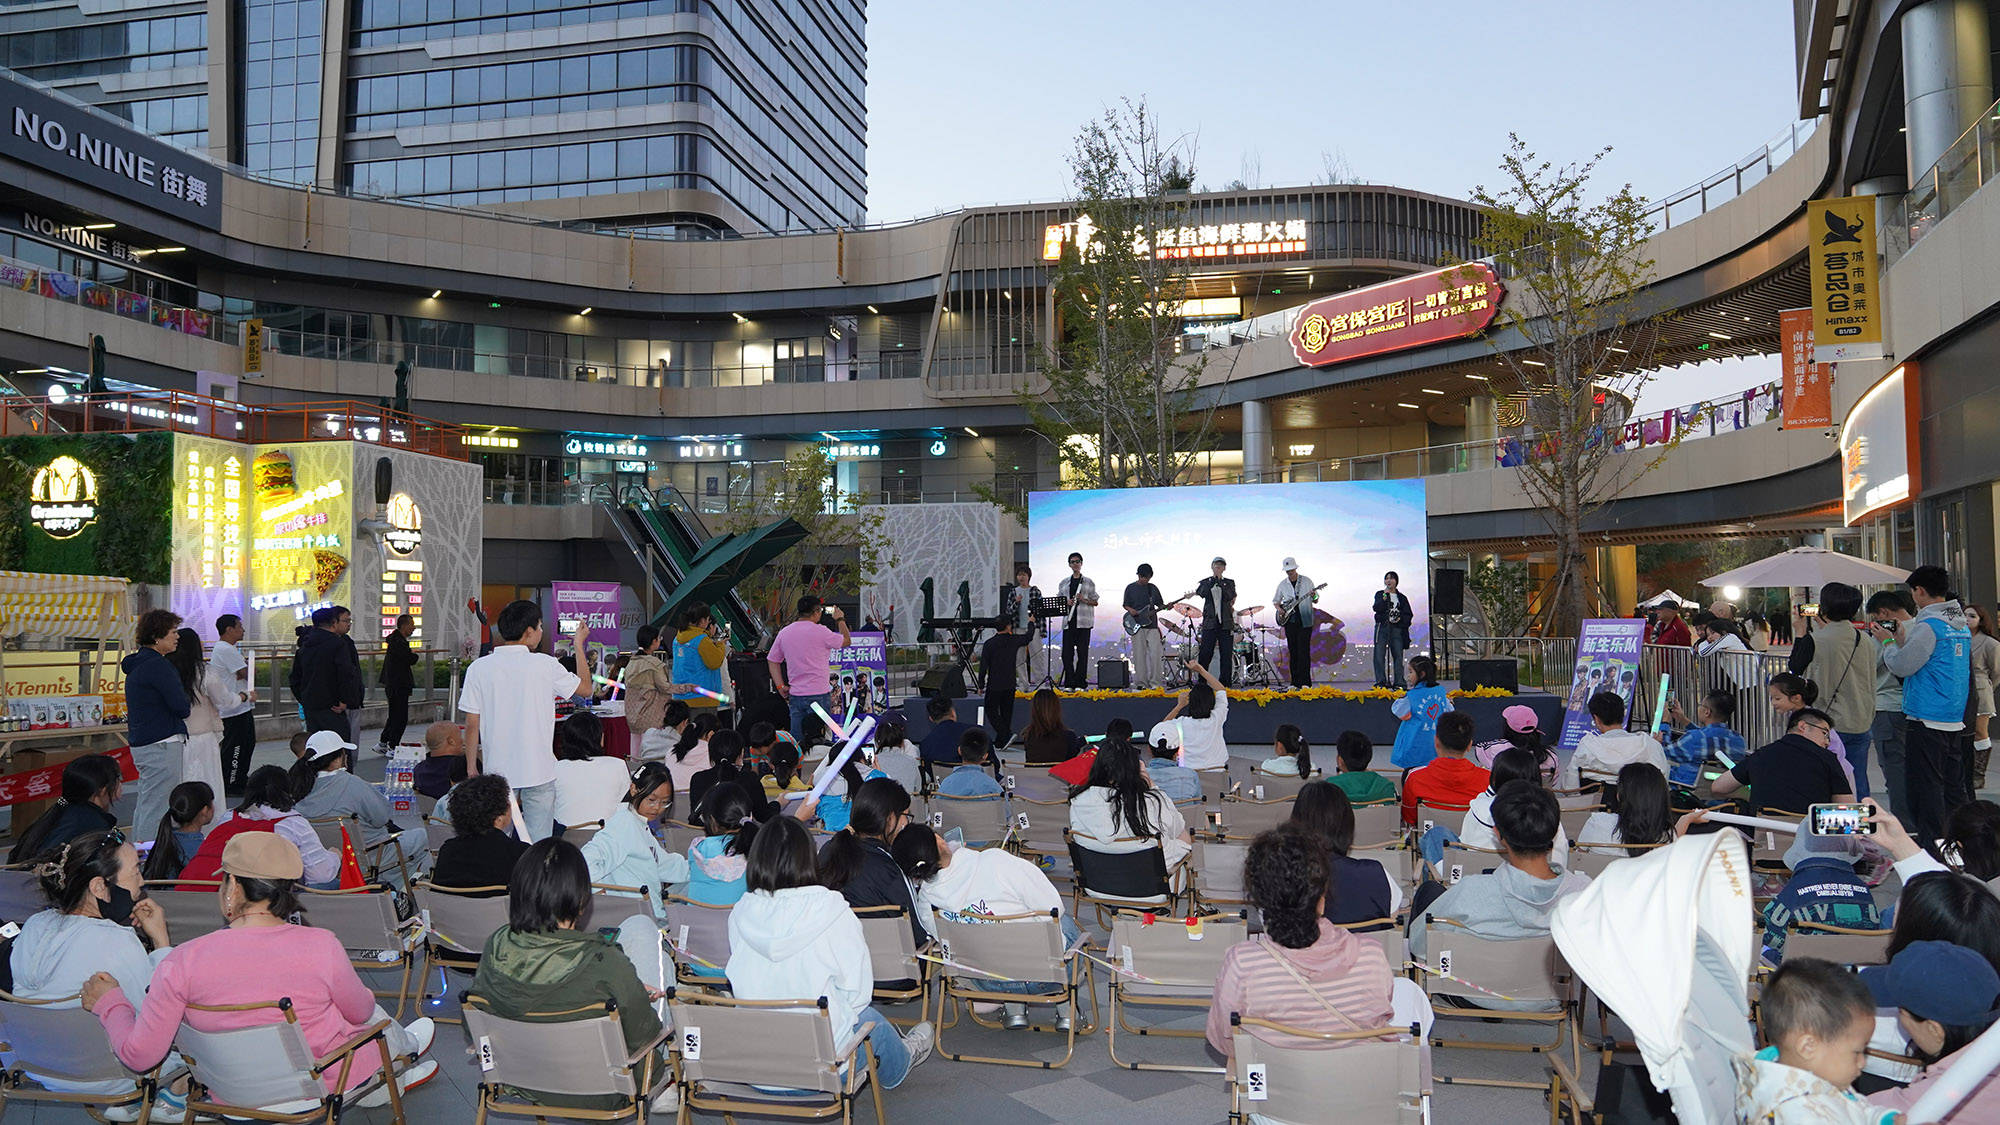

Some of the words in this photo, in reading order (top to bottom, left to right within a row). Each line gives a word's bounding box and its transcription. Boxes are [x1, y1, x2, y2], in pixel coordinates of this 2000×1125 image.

[14, 106, 155, 187] NO.NINE
[162, 166, 208, 207] 街舞
[24, 212, 108, 253] NO.NINE
[1852, 251, 1866, 311] 城市奥莱
[680, 445, 743, 458] MUTIE
[1582, 637, 1637, 653] 新生乐队
[0, 676, 73, 697] kTennis
